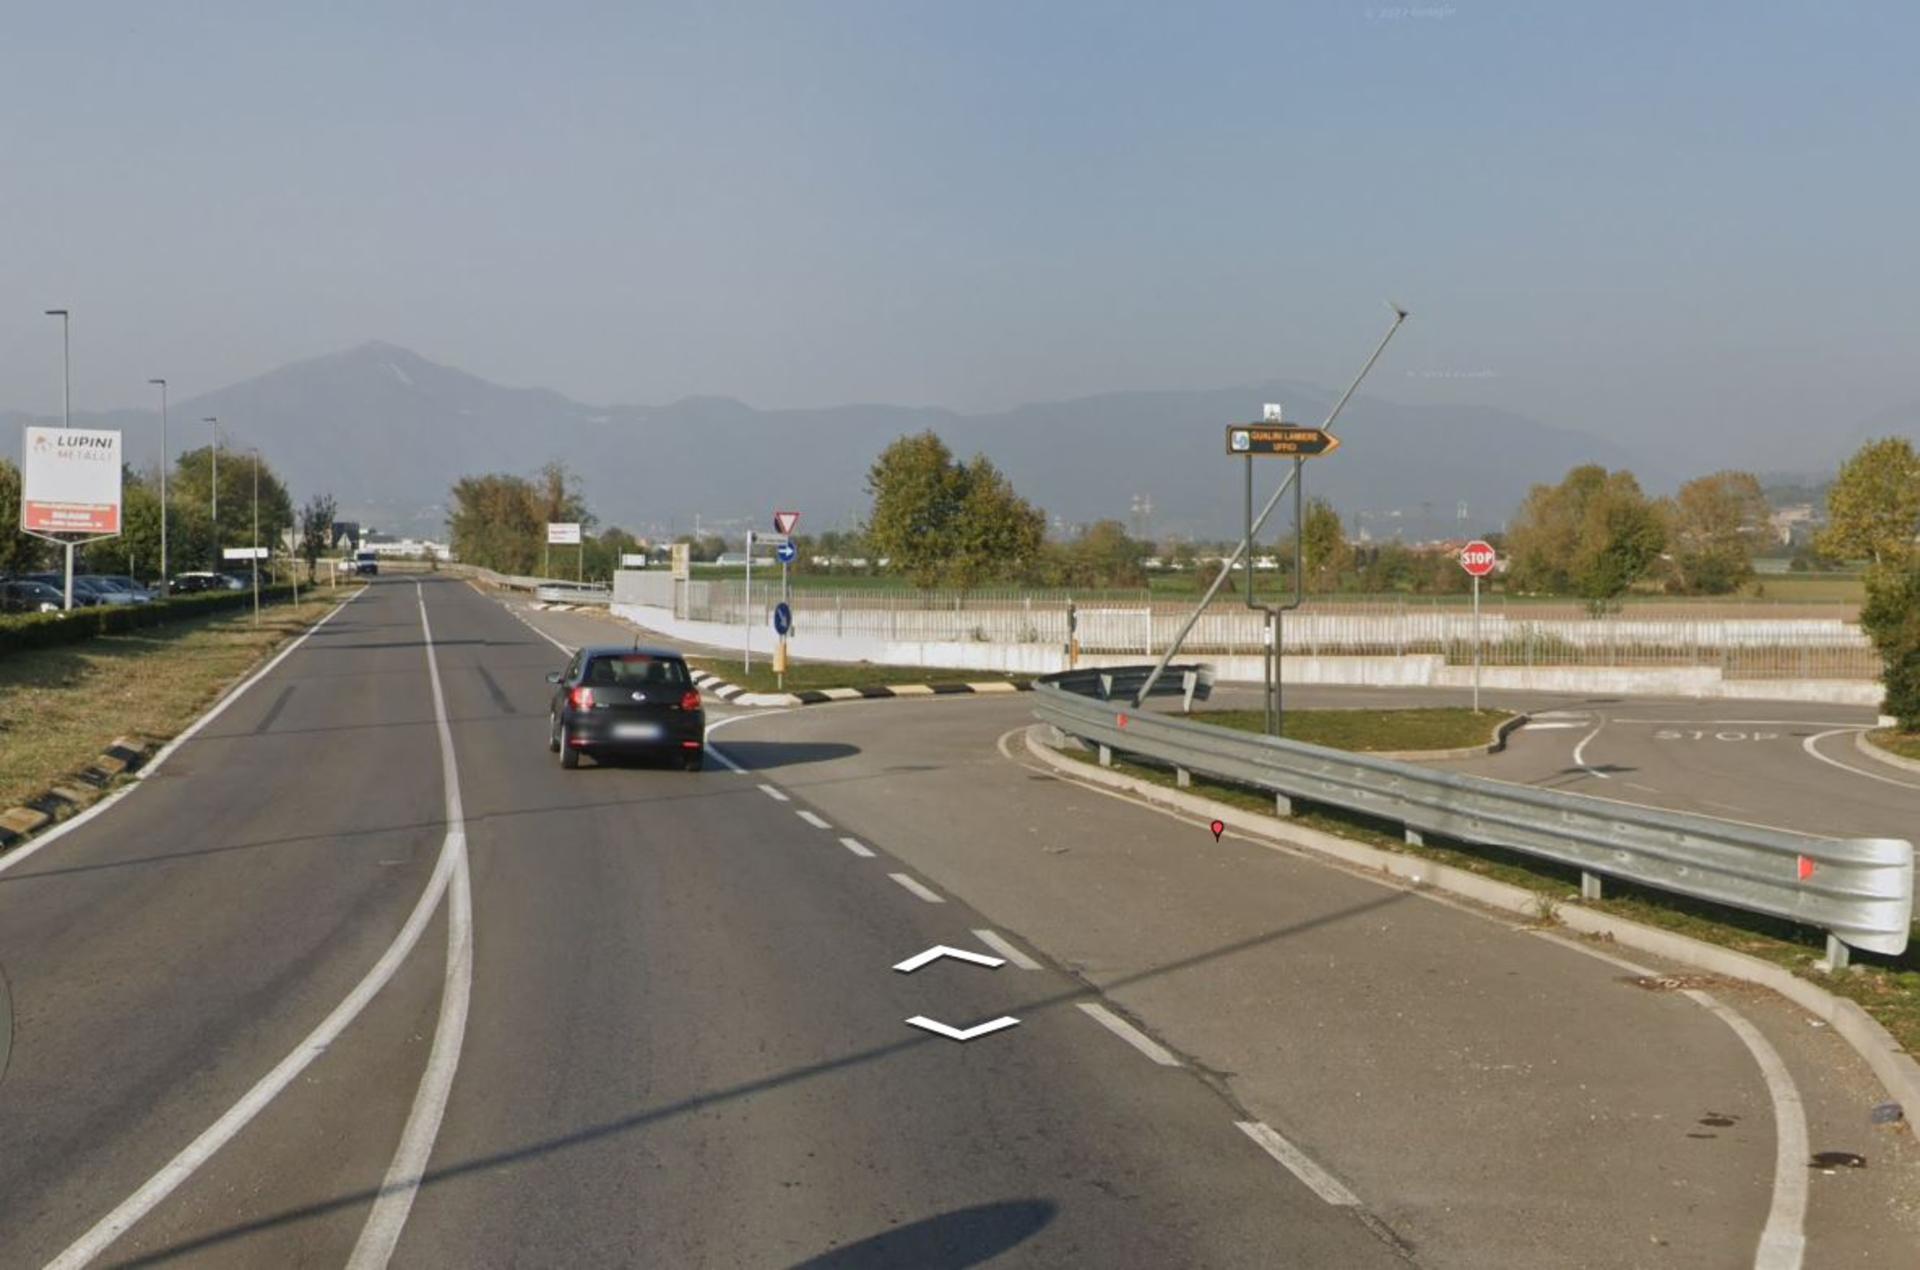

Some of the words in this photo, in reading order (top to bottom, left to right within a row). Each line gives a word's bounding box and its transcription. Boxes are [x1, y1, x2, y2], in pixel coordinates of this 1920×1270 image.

[57, 435, 113, 449] LUPINI
[1462, 552, 1492, 565] STOP
[1654, 730, 1779, 741] STOP
